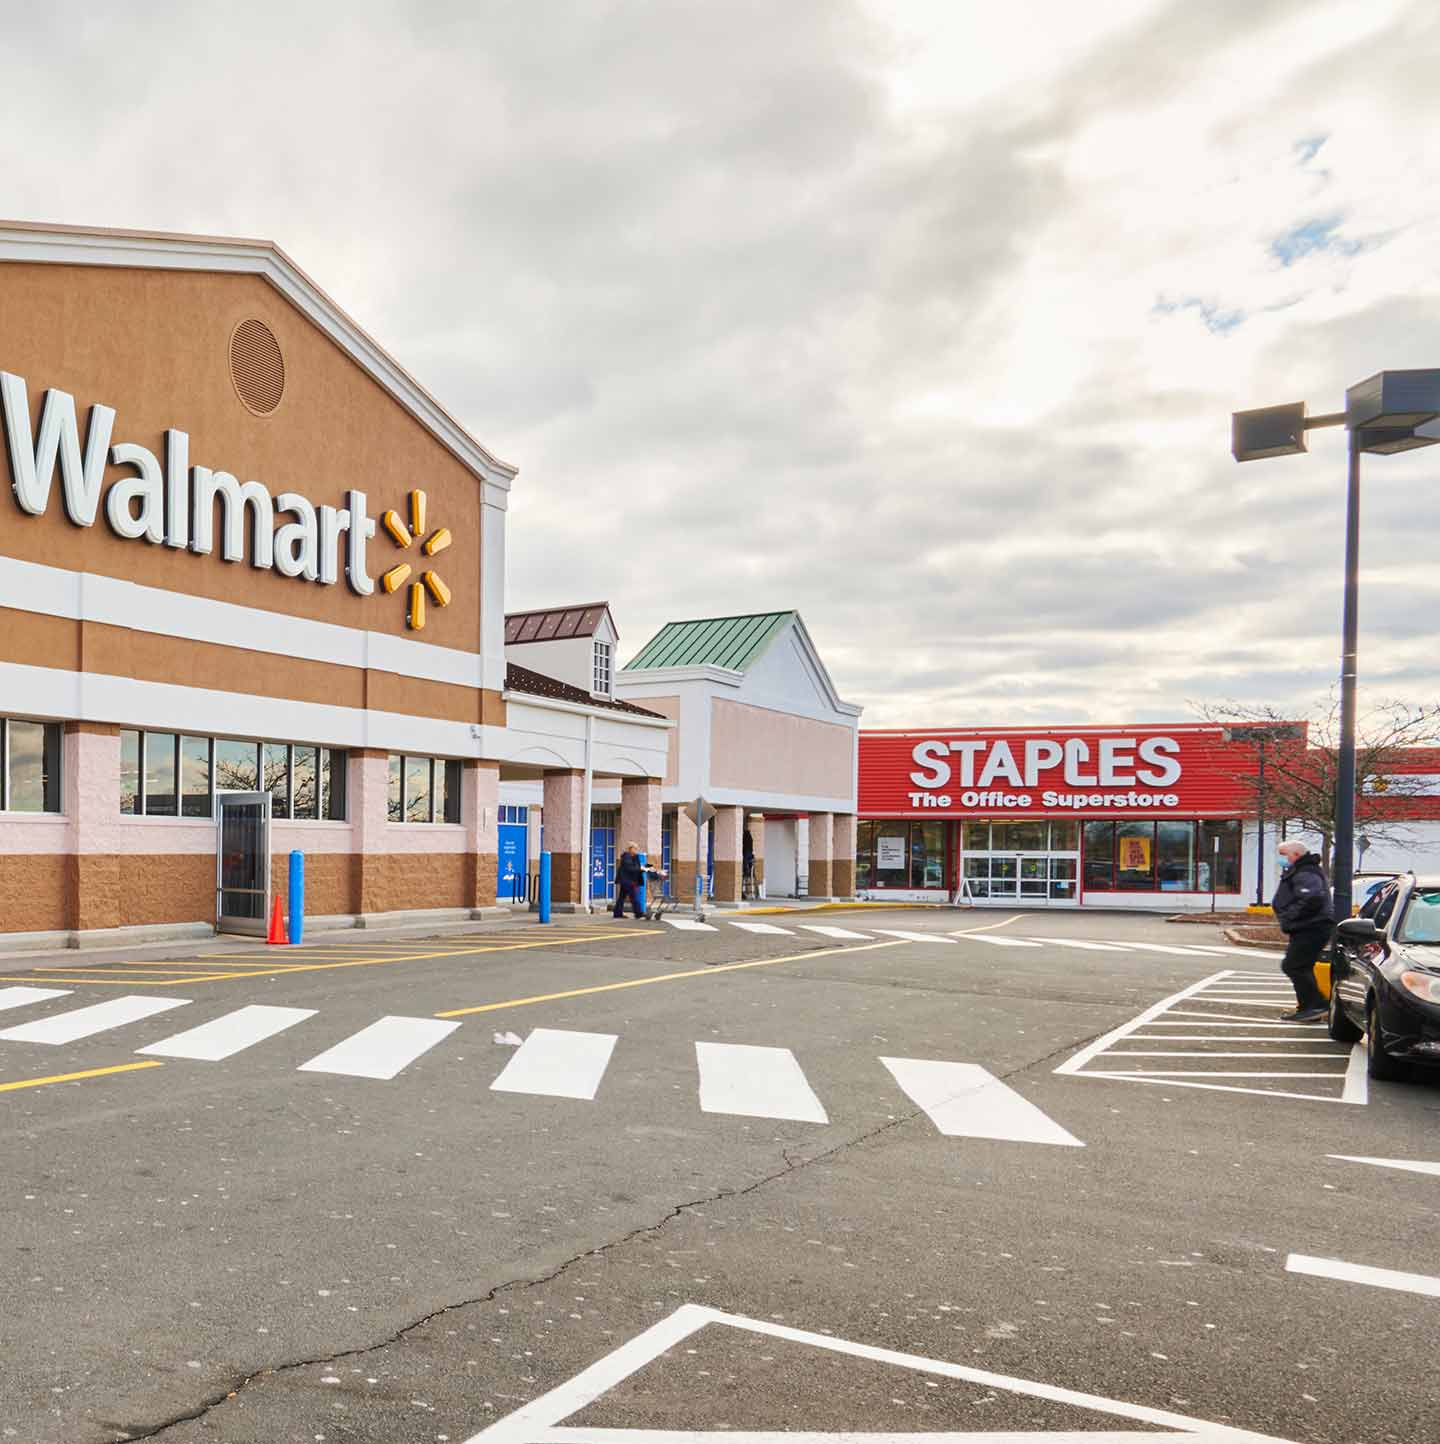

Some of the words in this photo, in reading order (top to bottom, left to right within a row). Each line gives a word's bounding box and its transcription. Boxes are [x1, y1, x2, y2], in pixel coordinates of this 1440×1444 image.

[910, 737, 1182, 788] STAPLES
[908, 792, 951, 808] The
[960, 791, 1032, 808] Office
[1042, 791, 1179, 808] Superstore
